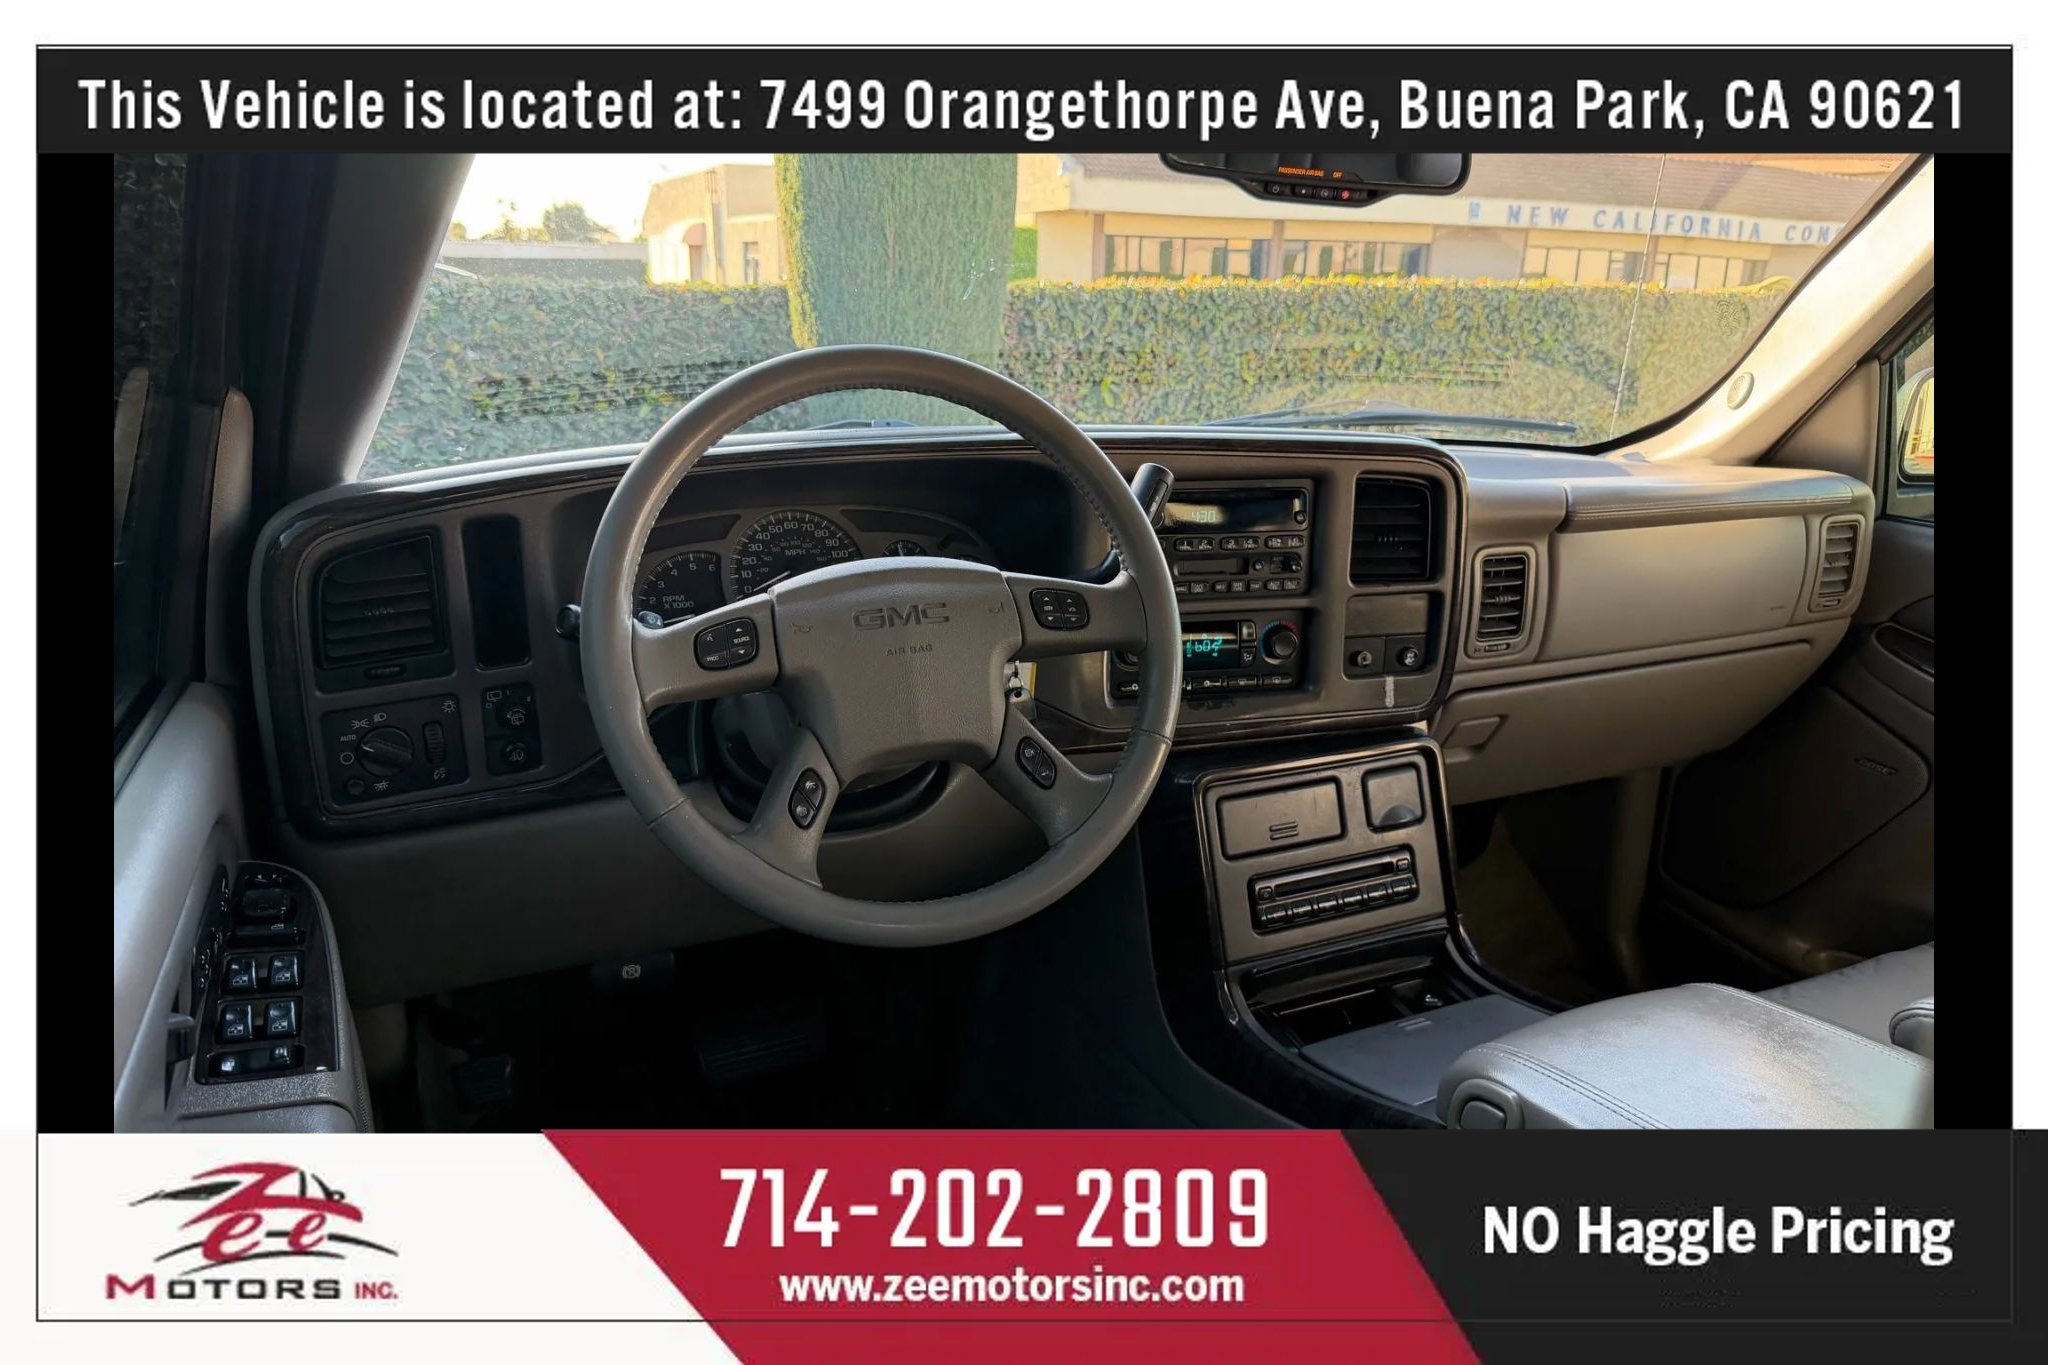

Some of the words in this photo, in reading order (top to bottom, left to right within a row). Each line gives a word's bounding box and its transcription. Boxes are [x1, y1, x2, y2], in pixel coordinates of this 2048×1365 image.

[1506, 204, 1569, 226] NEW
[1593, 209, 1761, 240] CALIFORNIA
[1784, 224, 1842, 243] CON
[768, 525, 783, 533] 50
[783, 521, 799, 530] 60
[800, 523, 815, 531] 70
[755, 532, 771, 540] 40
[814, 529, 829, 537] 80
[825, 539, 840, 547] 90
[748, 543, 763, 552] 30
[831, 550, 849, 558] 100
[742, 556, 757, 565] 20
[689, 562, 697, 571] 5
[708, 564, 716, 572] 6
[741, 570, 752, 578] 10
[657, 580, 665, 588] 3
[649, 596, 657, 605] 2
[852, 602, 949, 631] GMC
[886, 647, 906, 657] AIR
[911, 643, 933, 654] BAG
